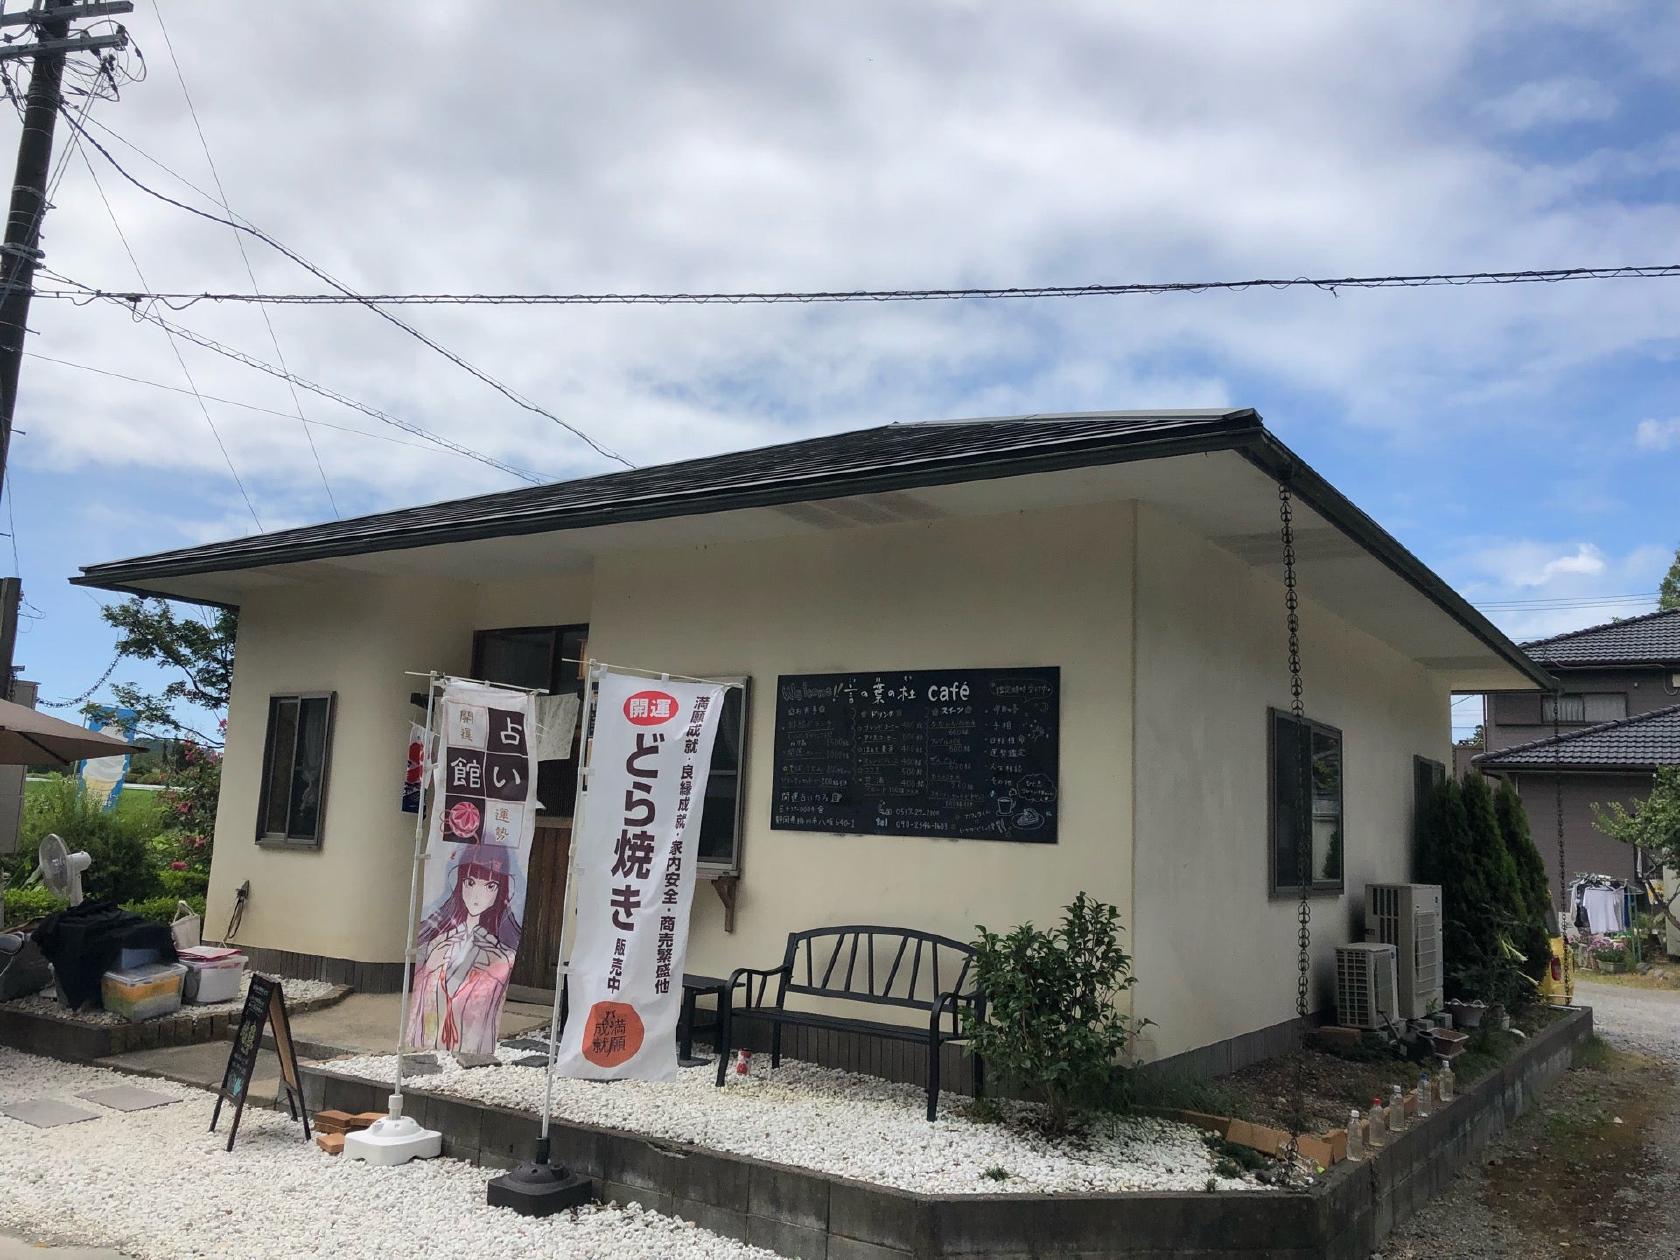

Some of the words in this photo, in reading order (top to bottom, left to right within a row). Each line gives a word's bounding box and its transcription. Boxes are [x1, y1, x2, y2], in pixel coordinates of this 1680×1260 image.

[928, 682, 970, 702] café
[630, 698, 672, 719] 開運
[460, 711, 474, 743] 開運
[611, 733, 666, 932] どら焼き
[607, 938, 627, 994] 販売中
